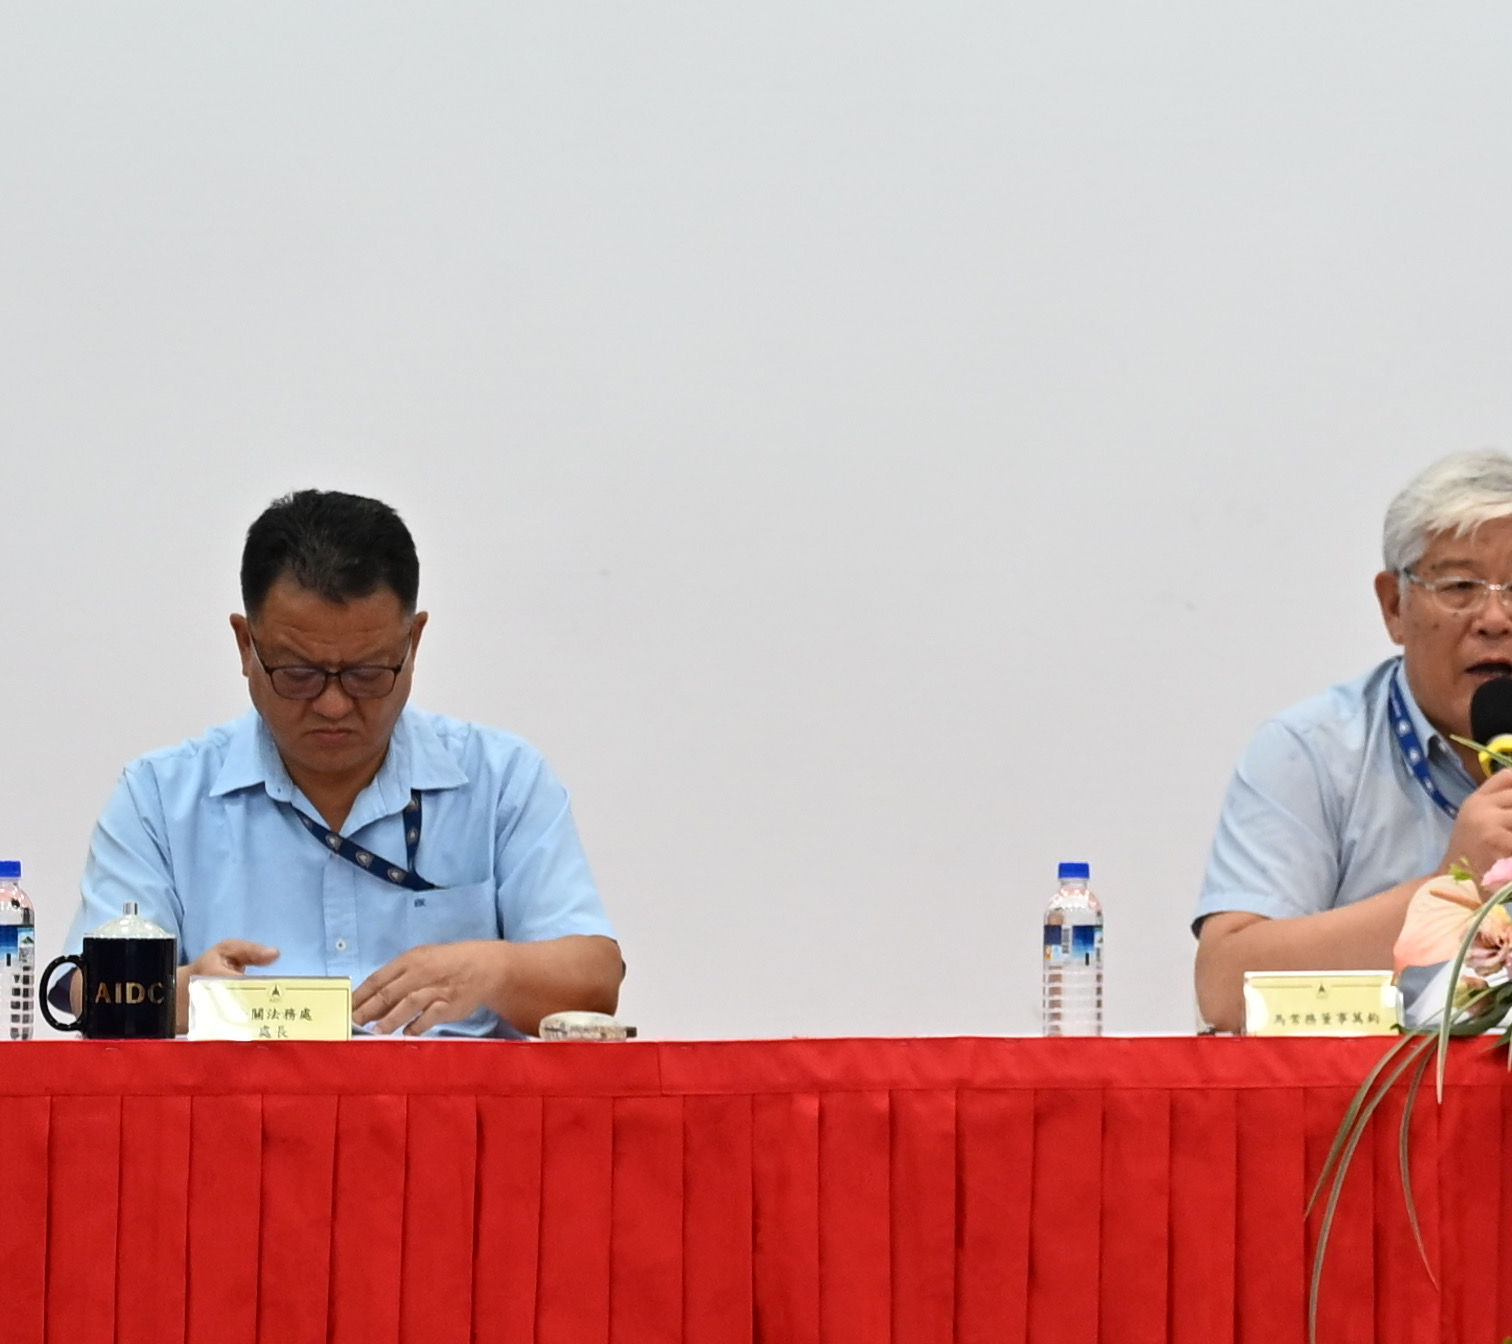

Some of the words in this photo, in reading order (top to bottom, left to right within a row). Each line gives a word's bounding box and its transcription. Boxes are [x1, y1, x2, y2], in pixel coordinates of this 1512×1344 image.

[95, 982, 165, 1004] AIDC
[251, 1007, 313, 1021] 關法務處
[259, 1024, 288, 1038] 處長
